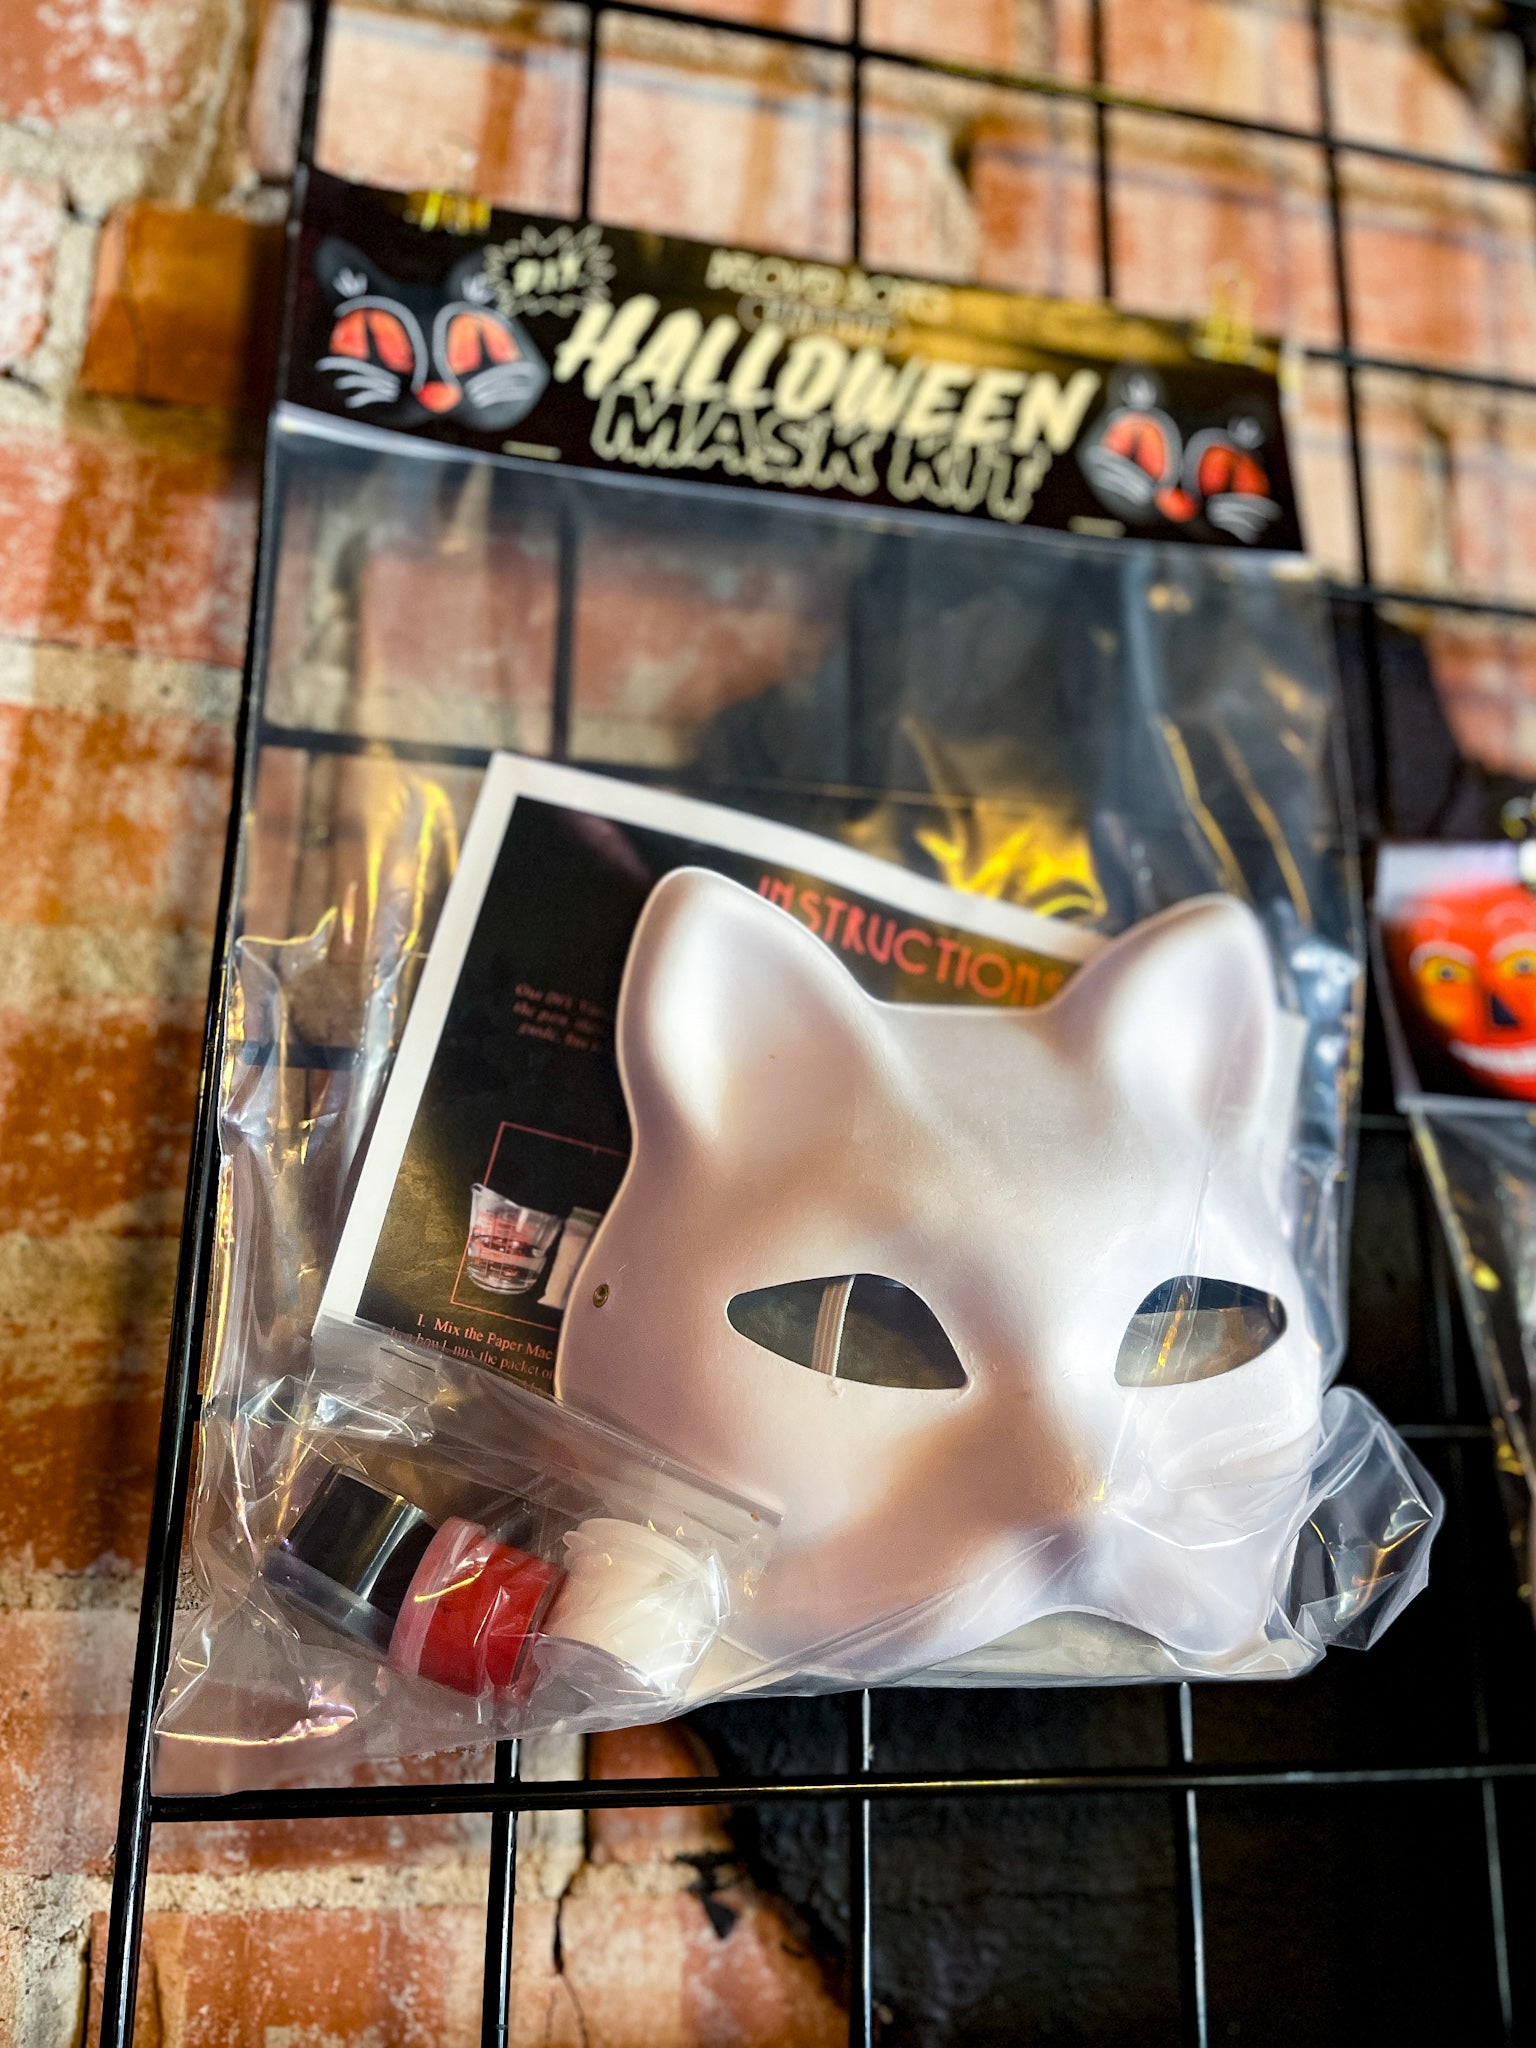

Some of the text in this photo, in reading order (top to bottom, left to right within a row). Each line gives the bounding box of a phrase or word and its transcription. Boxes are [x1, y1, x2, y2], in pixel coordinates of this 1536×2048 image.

[553, 293, 1101, 457] HALLOWEEN
[590, 382, 1055, 525] MASK KIT
[434, 1317, 460, 1337] Mix
[464, 1327, 484, 1342] the
[486, 1331, 523, 1351] Paper
[479, 1350, 497, 1365] the
[499, 1358, 539, 1376] packet
